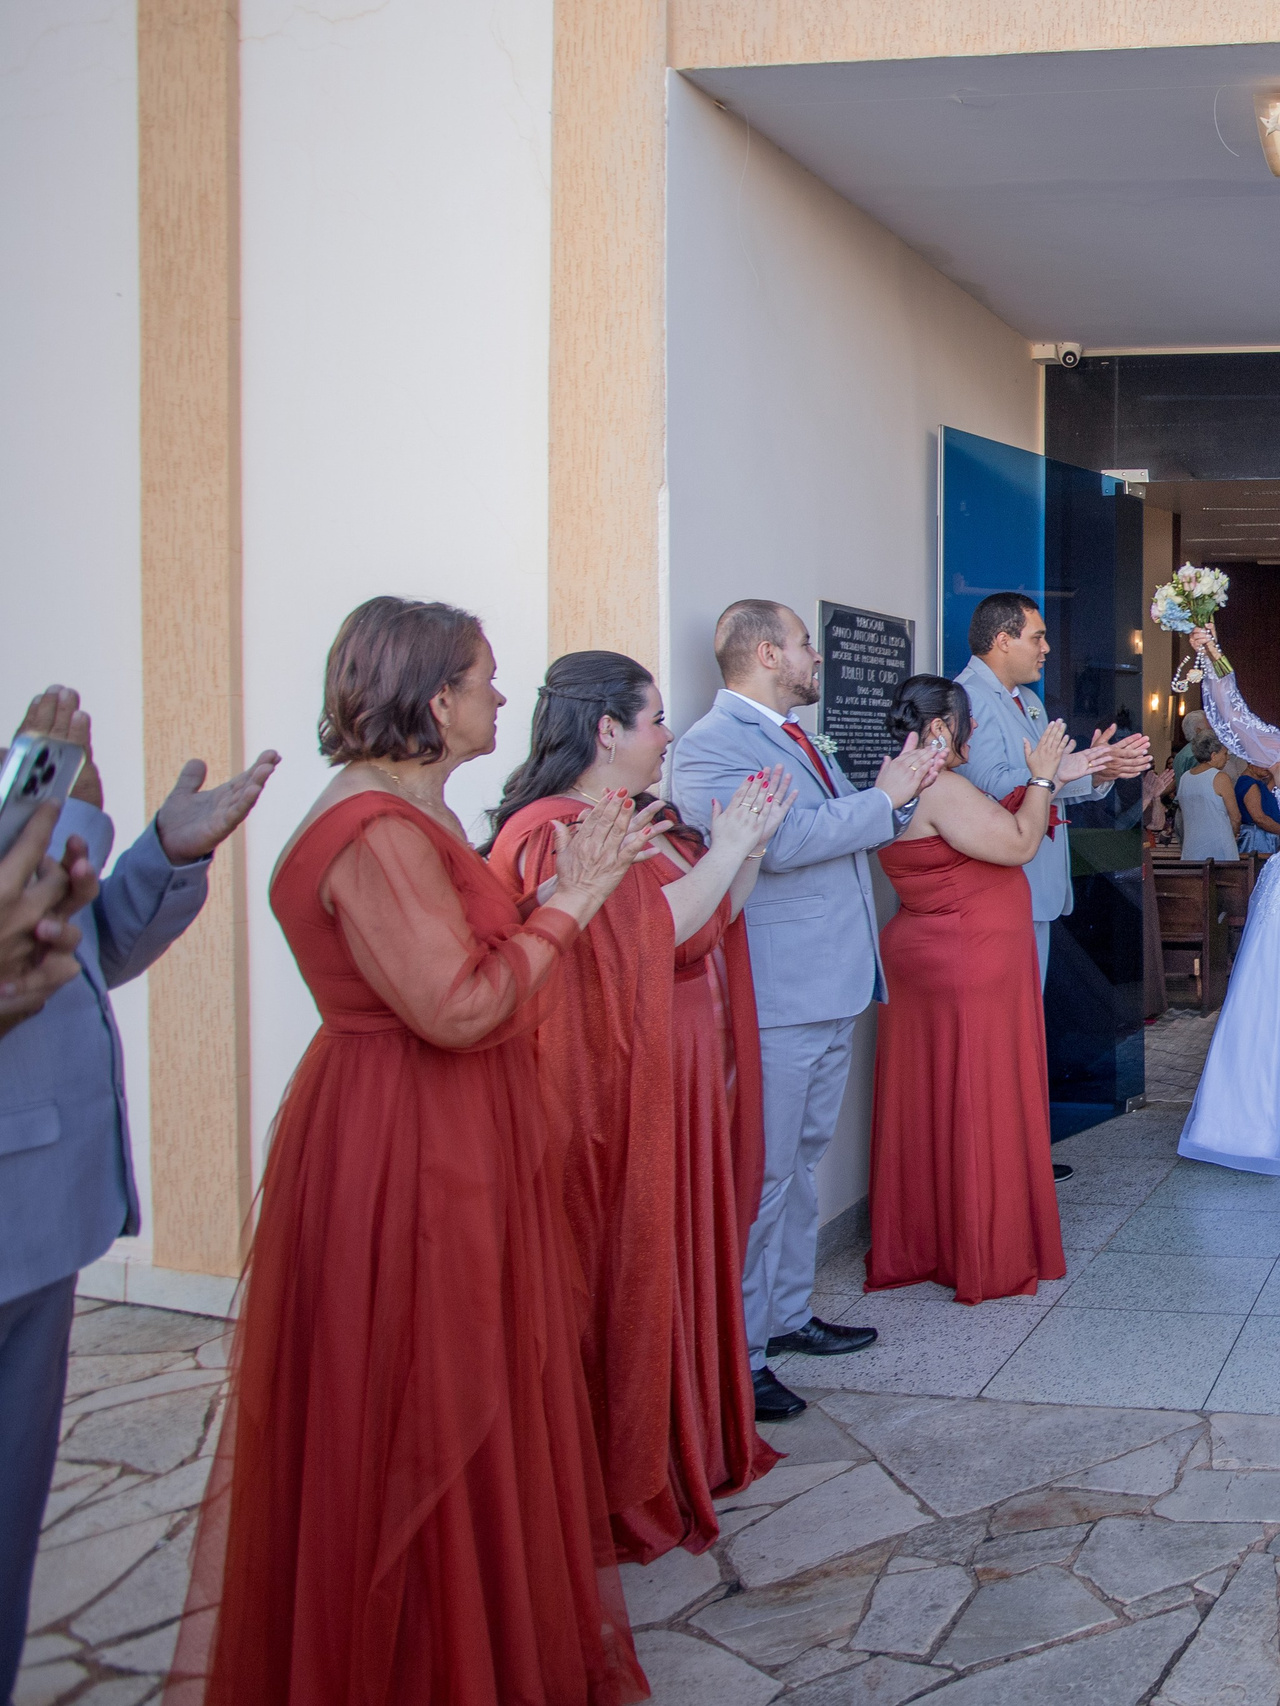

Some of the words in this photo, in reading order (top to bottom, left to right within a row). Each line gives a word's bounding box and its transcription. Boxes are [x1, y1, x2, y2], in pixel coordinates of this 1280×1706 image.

[880, 635, 887, 645] DE
[841, 665, 864, 681] JUBILEU
[867, 669, 876, 682] DE
[879, 670, 898, 685] OURO
